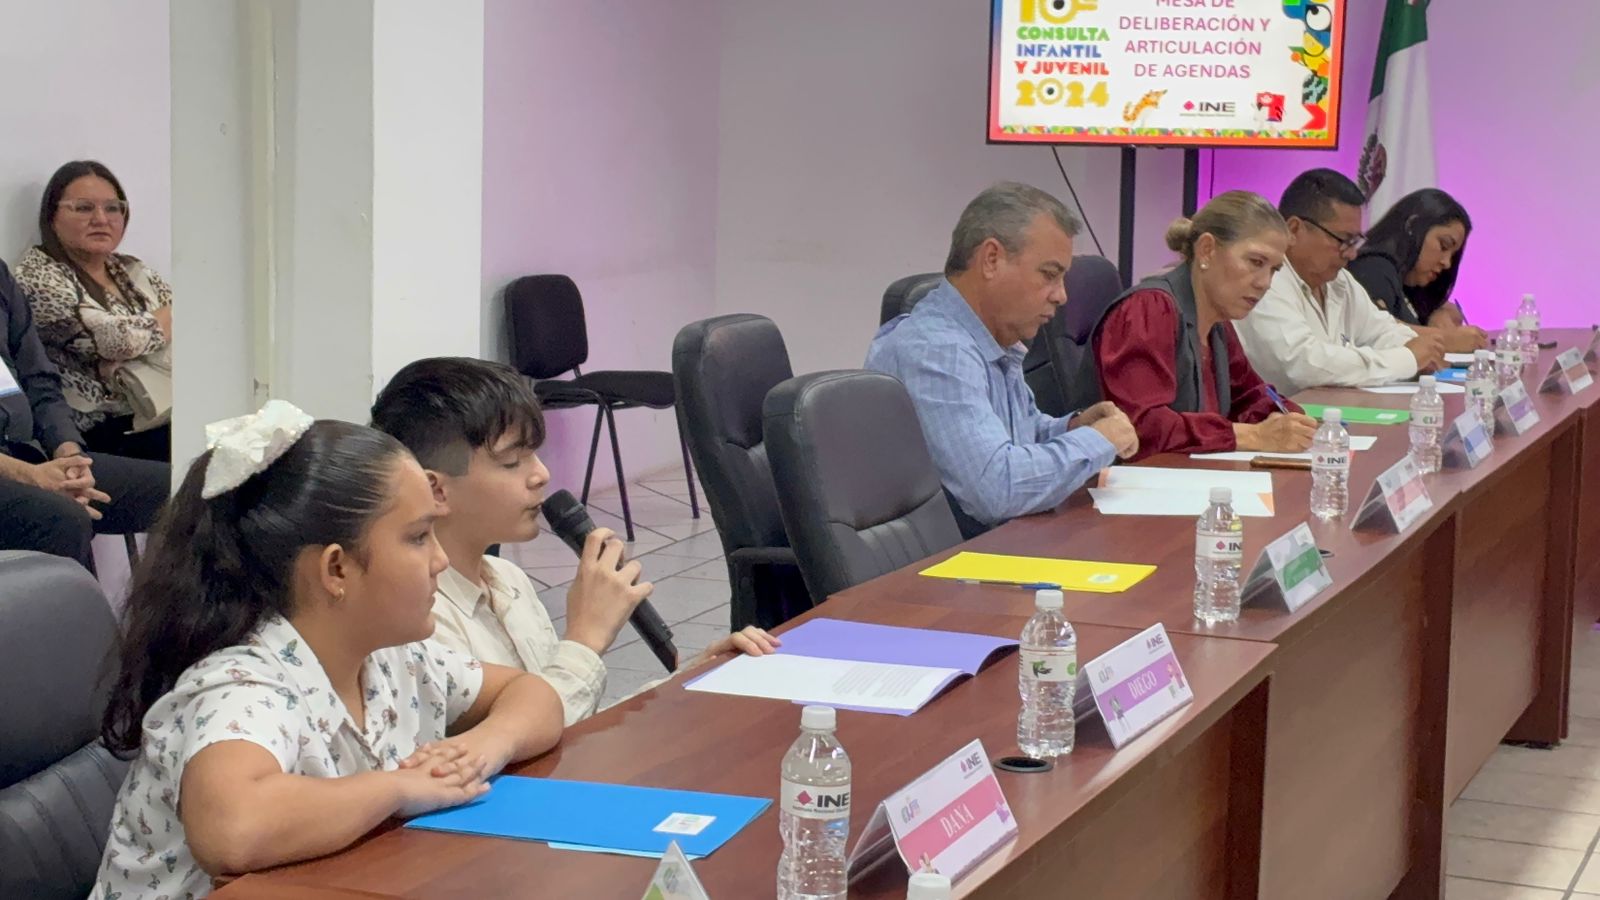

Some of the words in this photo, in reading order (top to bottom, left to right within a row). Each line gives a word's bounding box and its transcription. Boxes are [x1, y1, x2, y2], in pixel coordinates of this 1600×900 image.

[1119, 14, 1254, 32] DELIBERACIÓN
[1259, 18, 1271, 32] Y
[1016, 26, 1110, 41] CONSULTA
[1016, 43, 1102, 58] INFANTIL
[1124, 38, 1262, 55] ARTICULACIÓN
[1014, 61, 1028, 74] Y
[1032, 61, 1109, 75] JUVENIL
[1134, 63, 1158, 77] DE
[1162, 64, 1251, 79] AGENDAS
[1015, 78, 1110, 107] 2024
[1199, 101, 1236, 113] INE
[1228, 542, 1242, 552] IN
[1127, 670, 1158, 700] DIEGO
[966, 751, 982, 771] INE
[817, 791, 850, 808] INE
[940, 803, 975, 838] DANA
